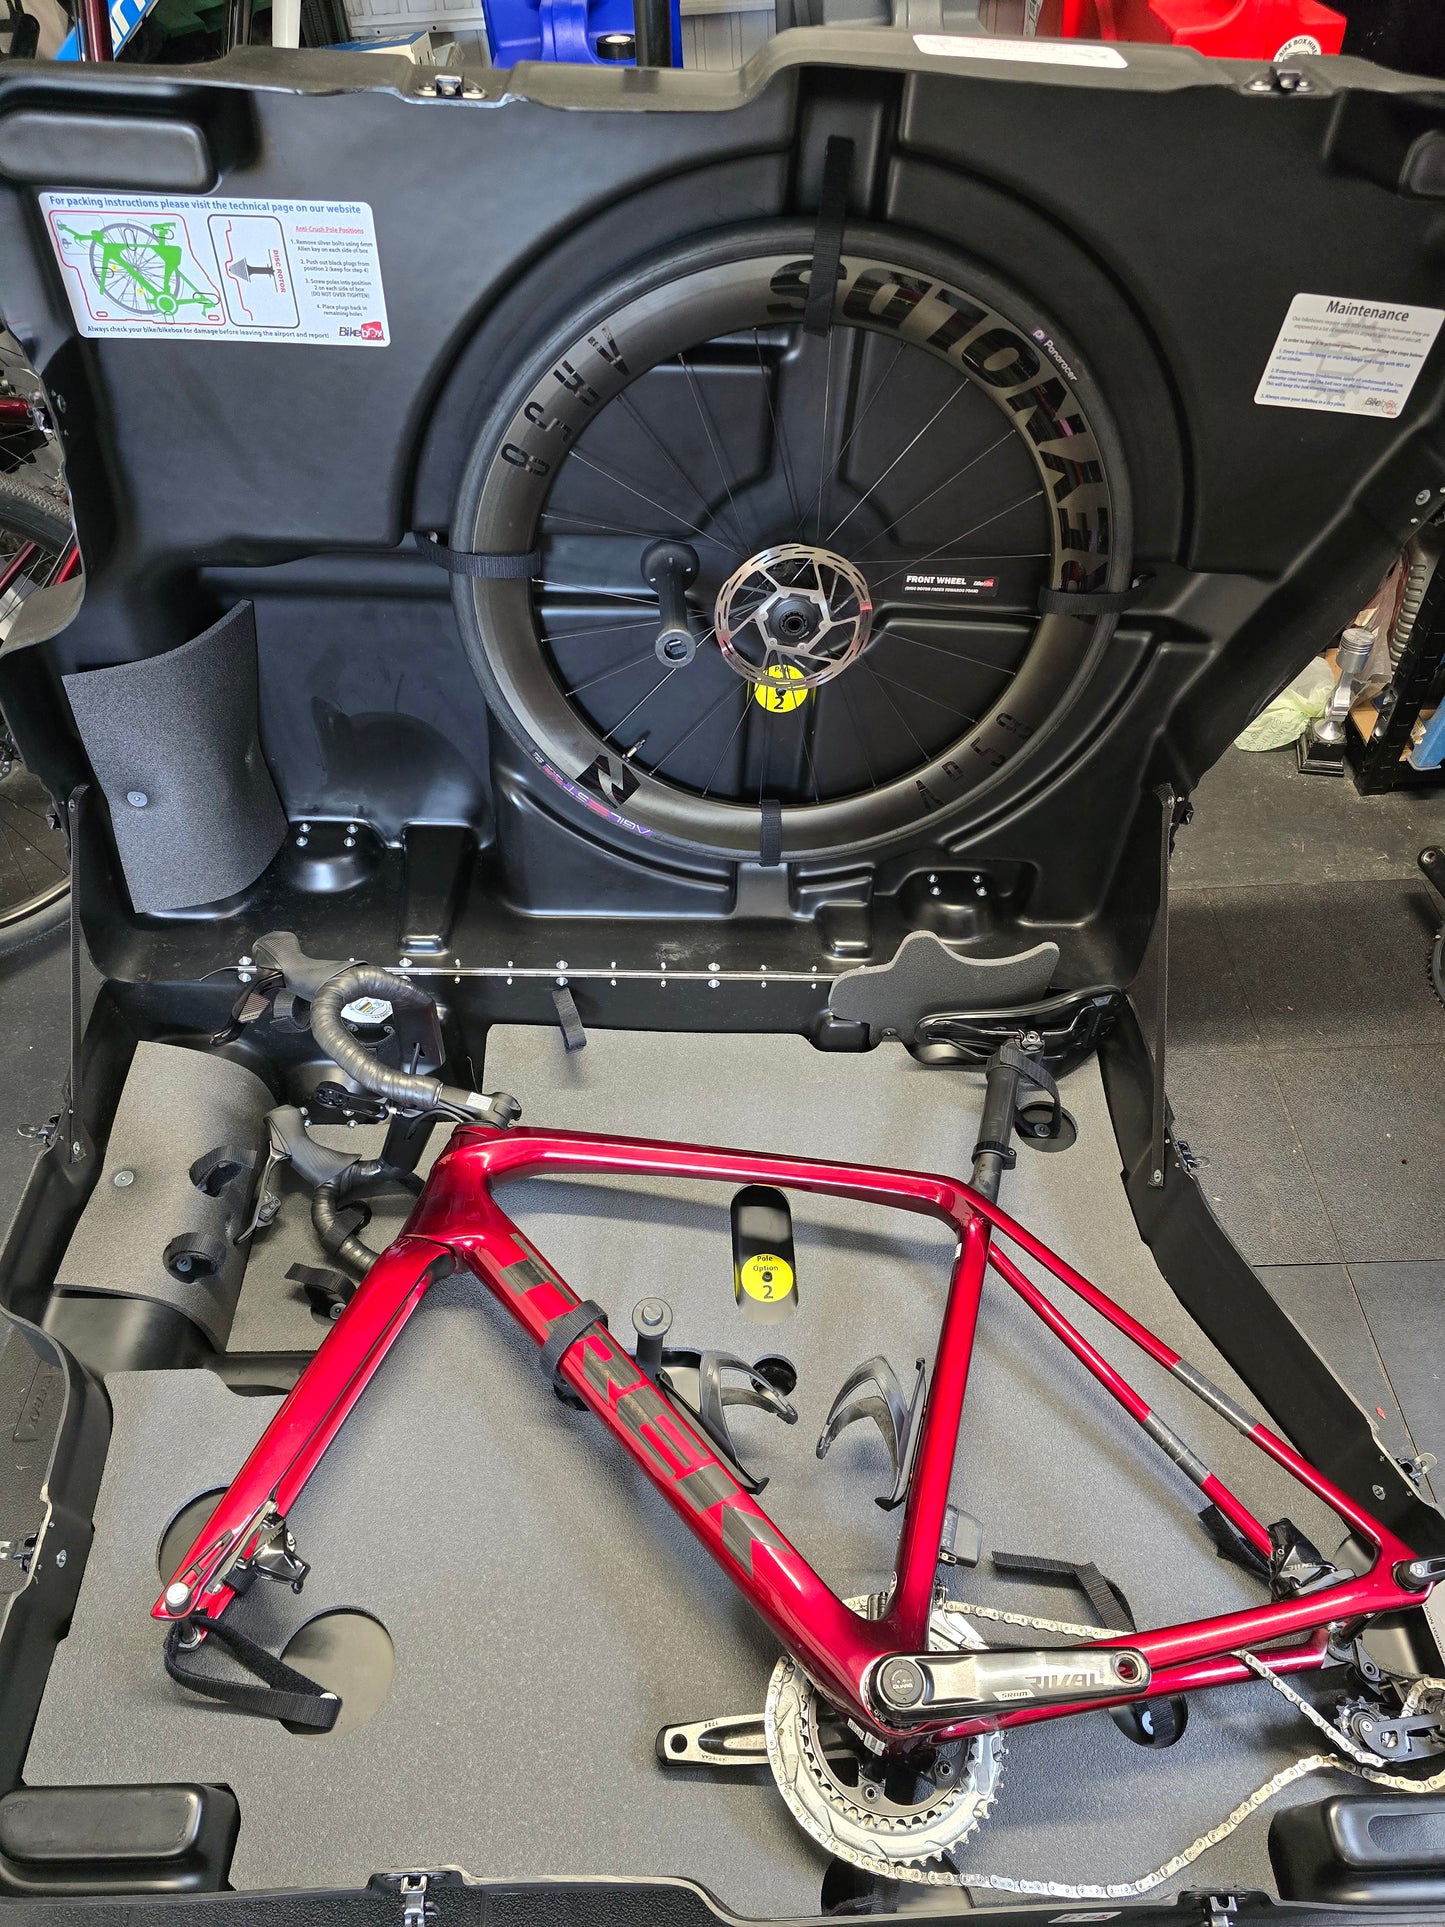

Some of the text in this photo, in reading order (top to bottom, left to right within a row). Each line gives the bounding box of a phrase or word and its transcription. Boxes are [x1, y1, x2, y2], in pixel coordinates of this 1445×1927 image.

[1279, 42, 1292, 57] BIKE
[49, 196, 360, 214] For packing instructions please visit the technical page on our website
[273, 249, 286, 293] DISC ROTOR
[1326, 300, 1409, 322] Maintenance
[240, 330, 262, 338] leaving
[274, 331, 295, 339] airport
[1044, 340, 1078, 381] Panaracer
[906, 575, 967, 585] FRONT WHEEL
[774, 696, 784, 710] 2
[763, 1285, 773, 1299] 2
[500, 1233, 793, 1580] TREK
[1025, 1673, 1105, 1689] RIVAL
